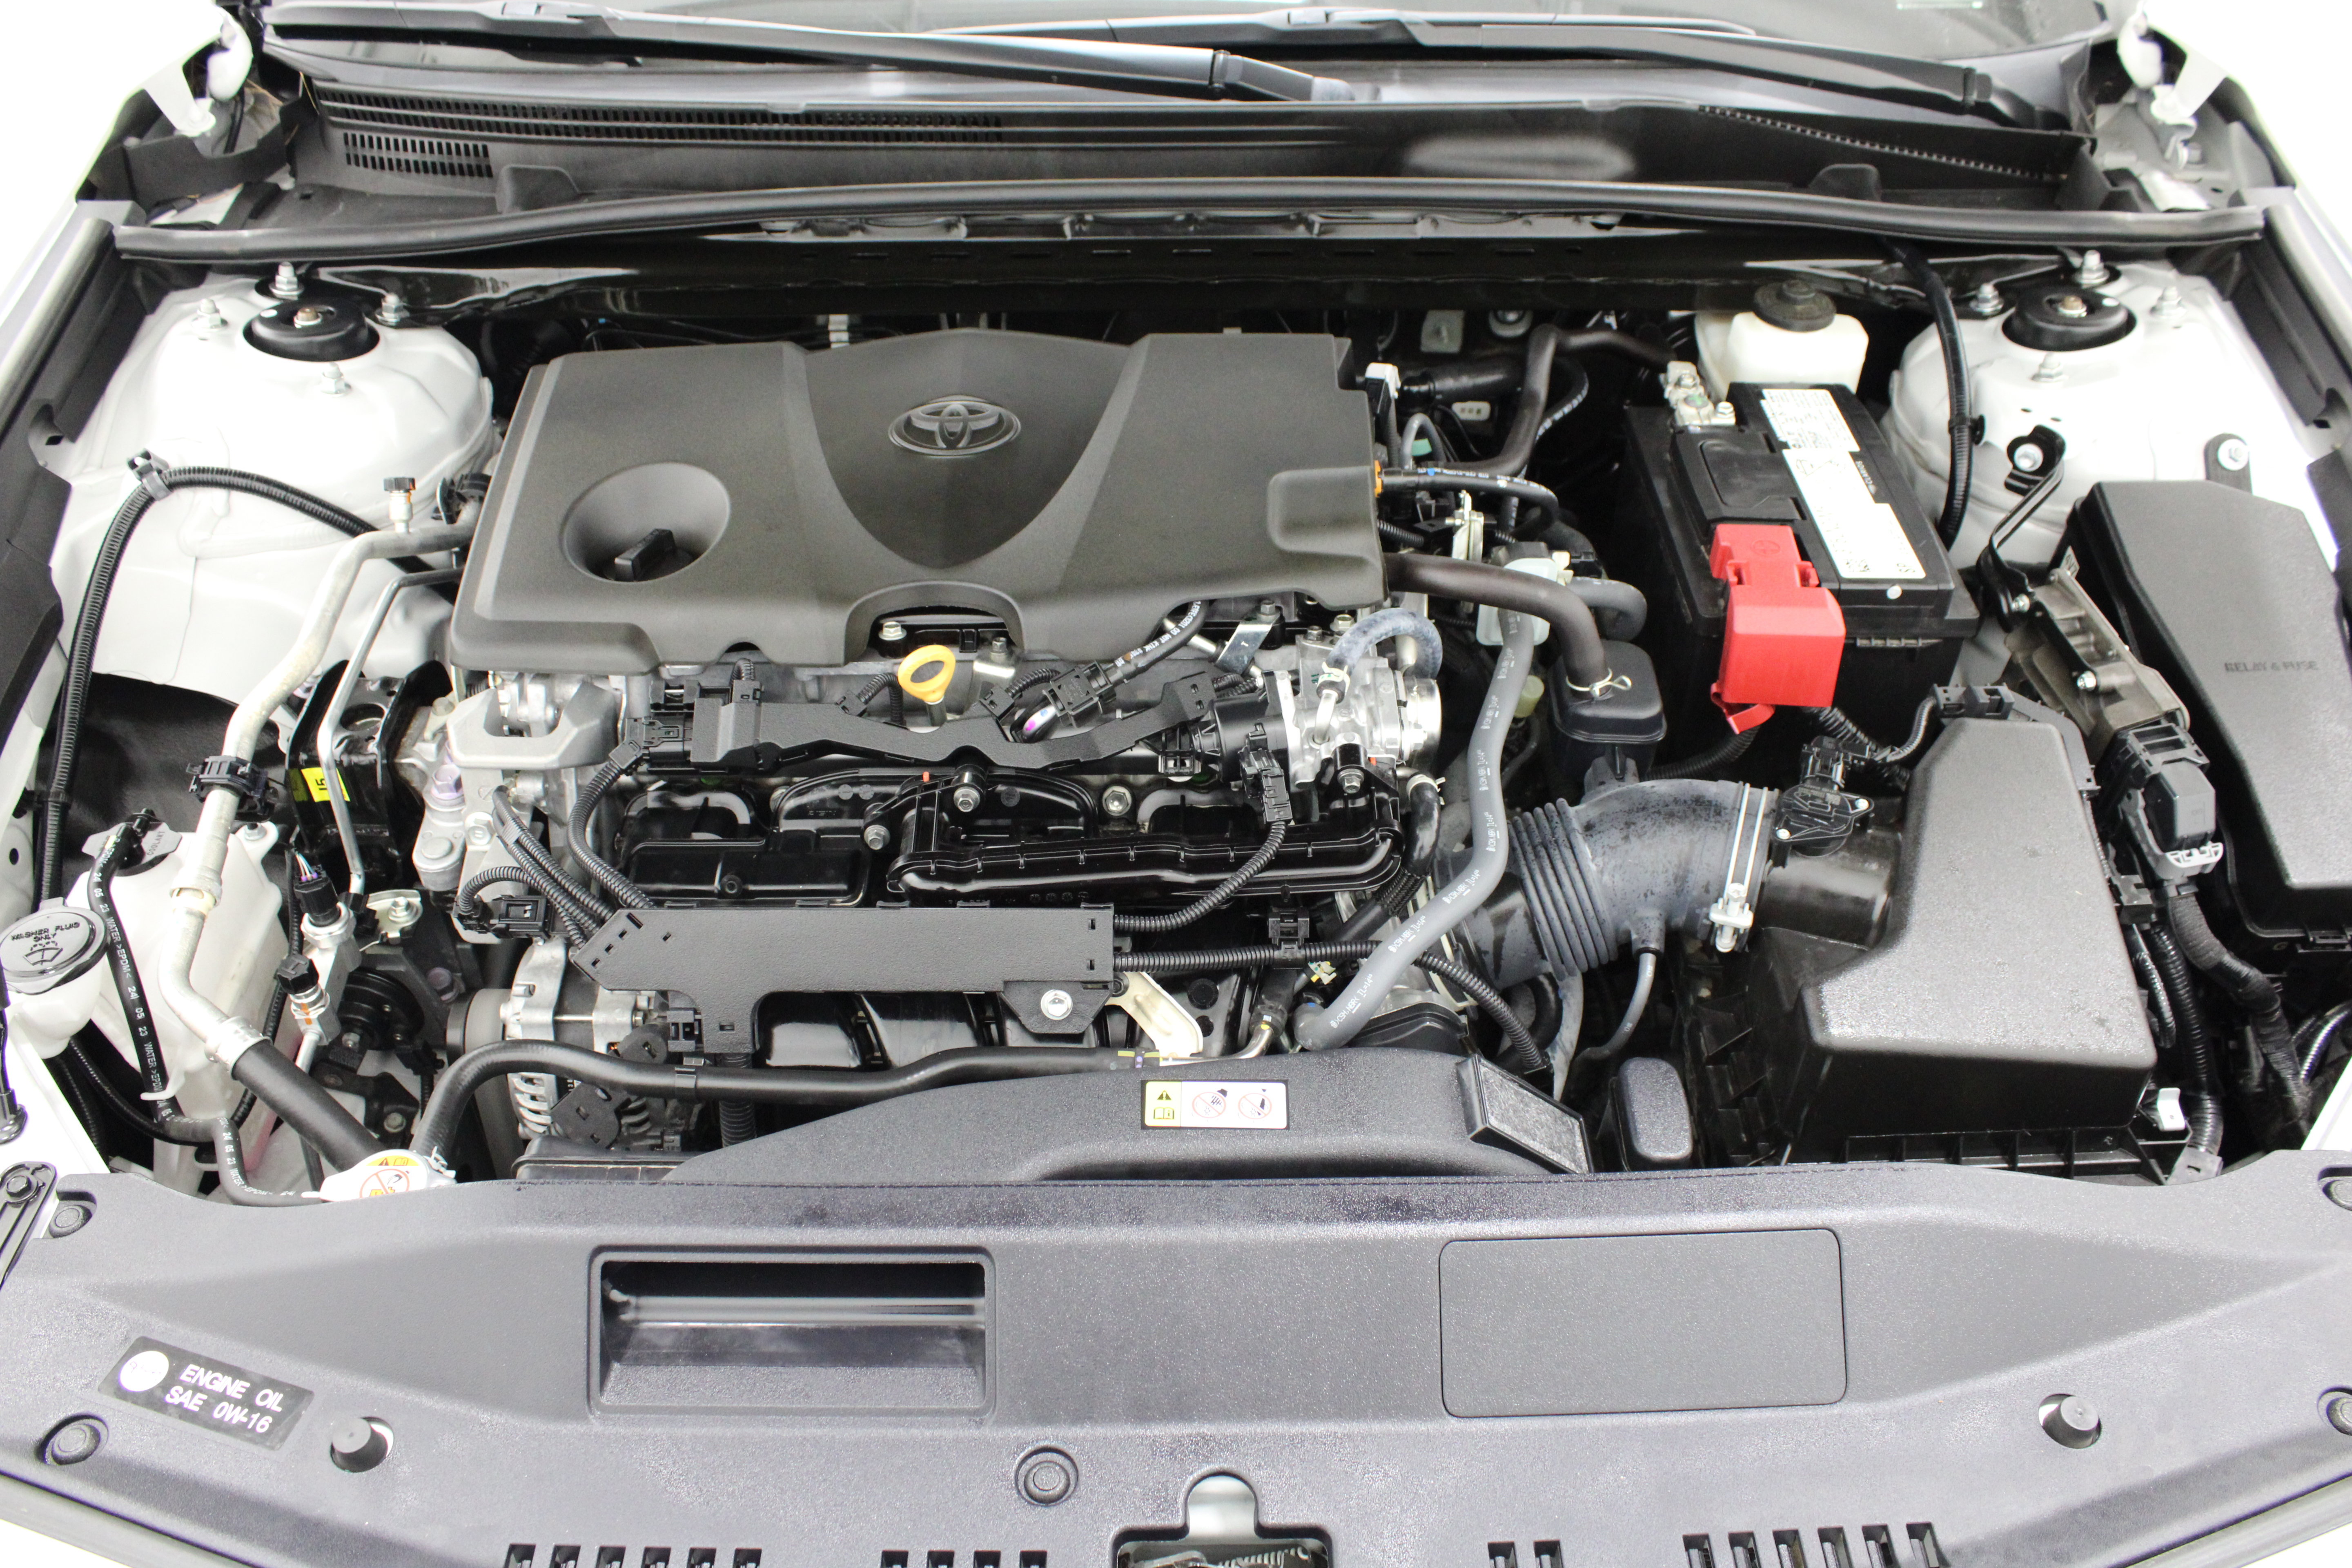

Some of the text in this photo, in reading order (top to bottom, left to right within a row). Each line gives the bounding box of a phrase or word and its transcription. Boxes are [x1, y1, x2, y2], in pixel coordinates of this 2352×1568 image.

[147, 831, 165, 856] COOLANT
[33, 933, 57, 942] ONLY
[55, 922, 80, 932] FLUID
[105, 917, 121, 943] WATER
[138, 1026, 148, 1037] 23
[144, 1041, 157, 1069] WATER
[151, 1069, 163, 1093] >EPDM
[229, 1167, 245, 1187] WATER
[179, 1363, 284, 1413] ENGINE OIL
[164, 1385, 273, 1434] SAE 0W-16
